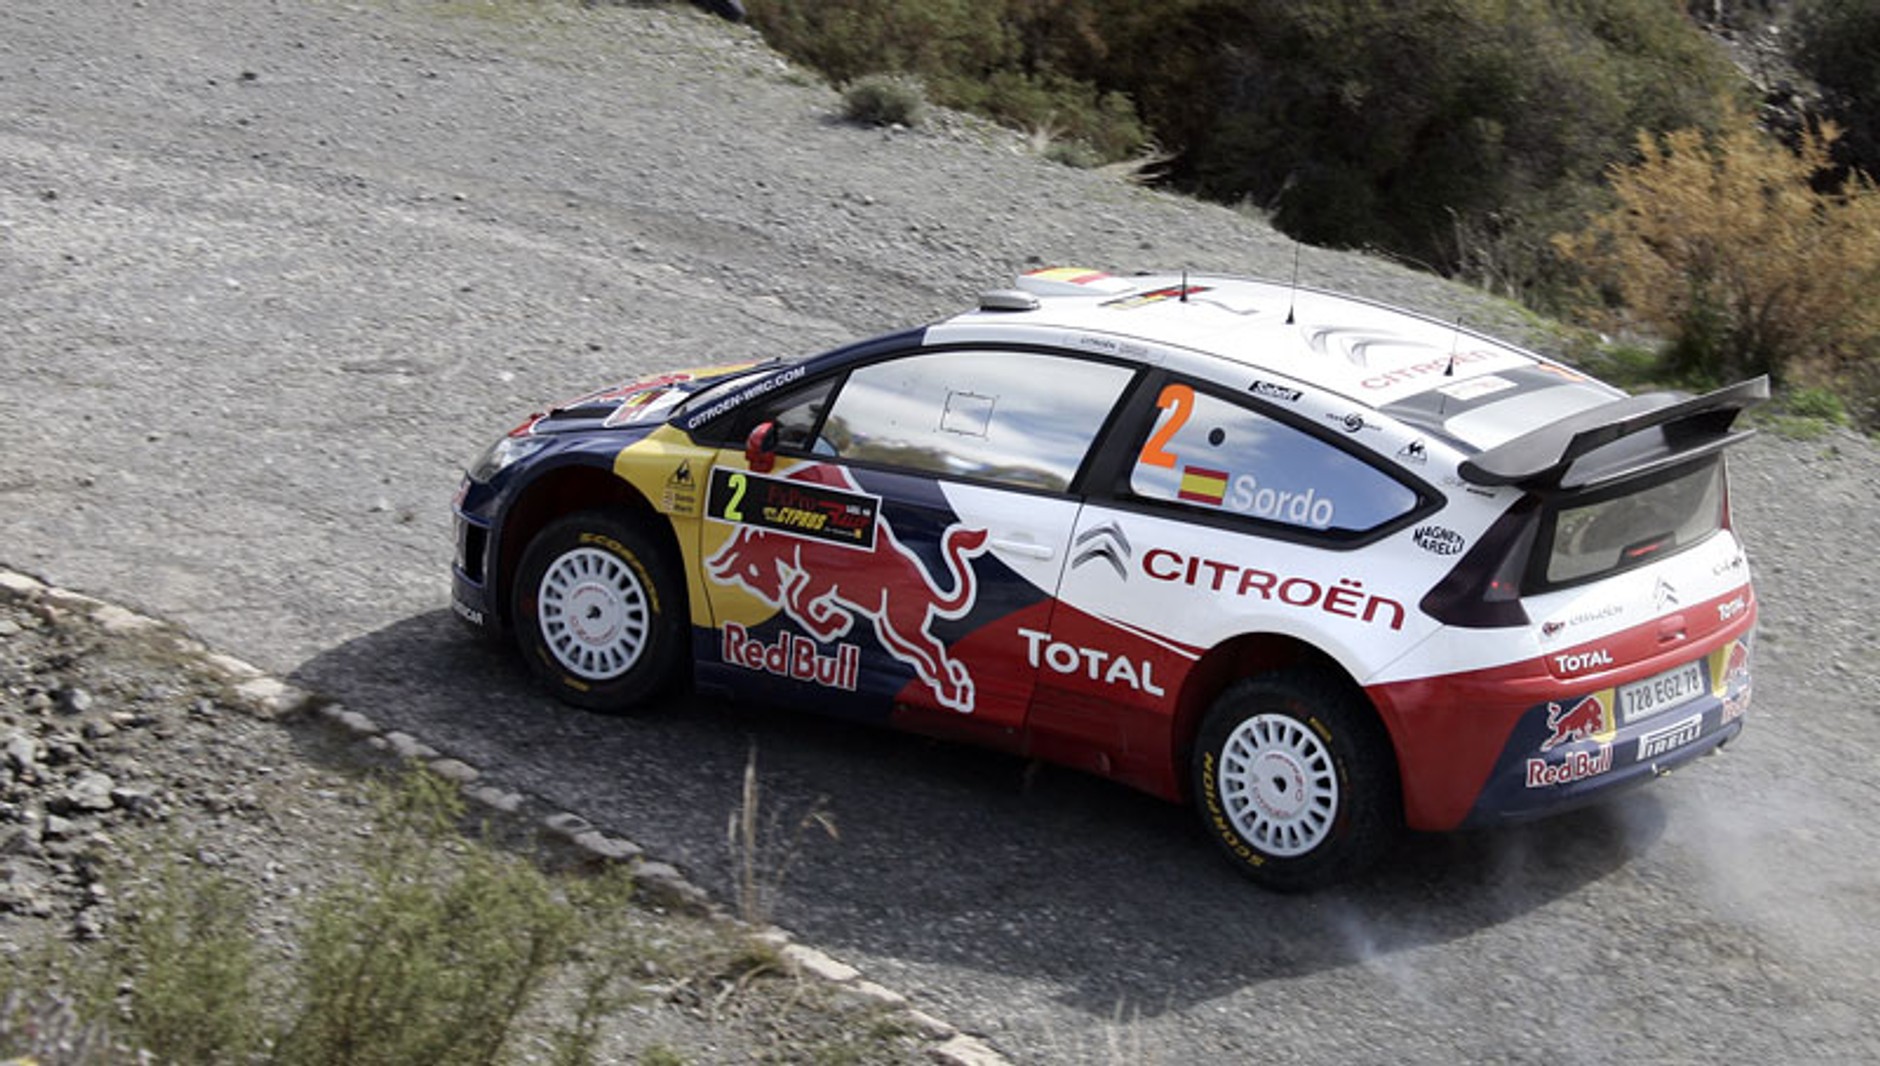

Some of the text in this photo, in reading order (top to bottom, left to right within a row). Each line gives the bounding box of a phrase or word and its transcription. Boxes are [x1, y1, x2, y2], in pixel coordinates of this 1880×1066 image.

[688, 366, 806, 429] CITROEN-WRC.COM
[1140, 383, 1196, 469] 2
[724, 473, 747, 521] 2
[1231, 474, 1334, 527] Sordo
[1142, 547, 1407, 632] CITROËN
[723, 620, 861, 692] Red Bull
[1018, 628, 1165, 697] TOTAL
[1555, 648, 1614, 674] TOTAL
[1626, 685, 1653, 715] 728
[1654, 676, 1684, 704] EGZ
[1635, 713, 1703, 763] PIRELLI
[1526, 742, 1614, 788] Red Bull
